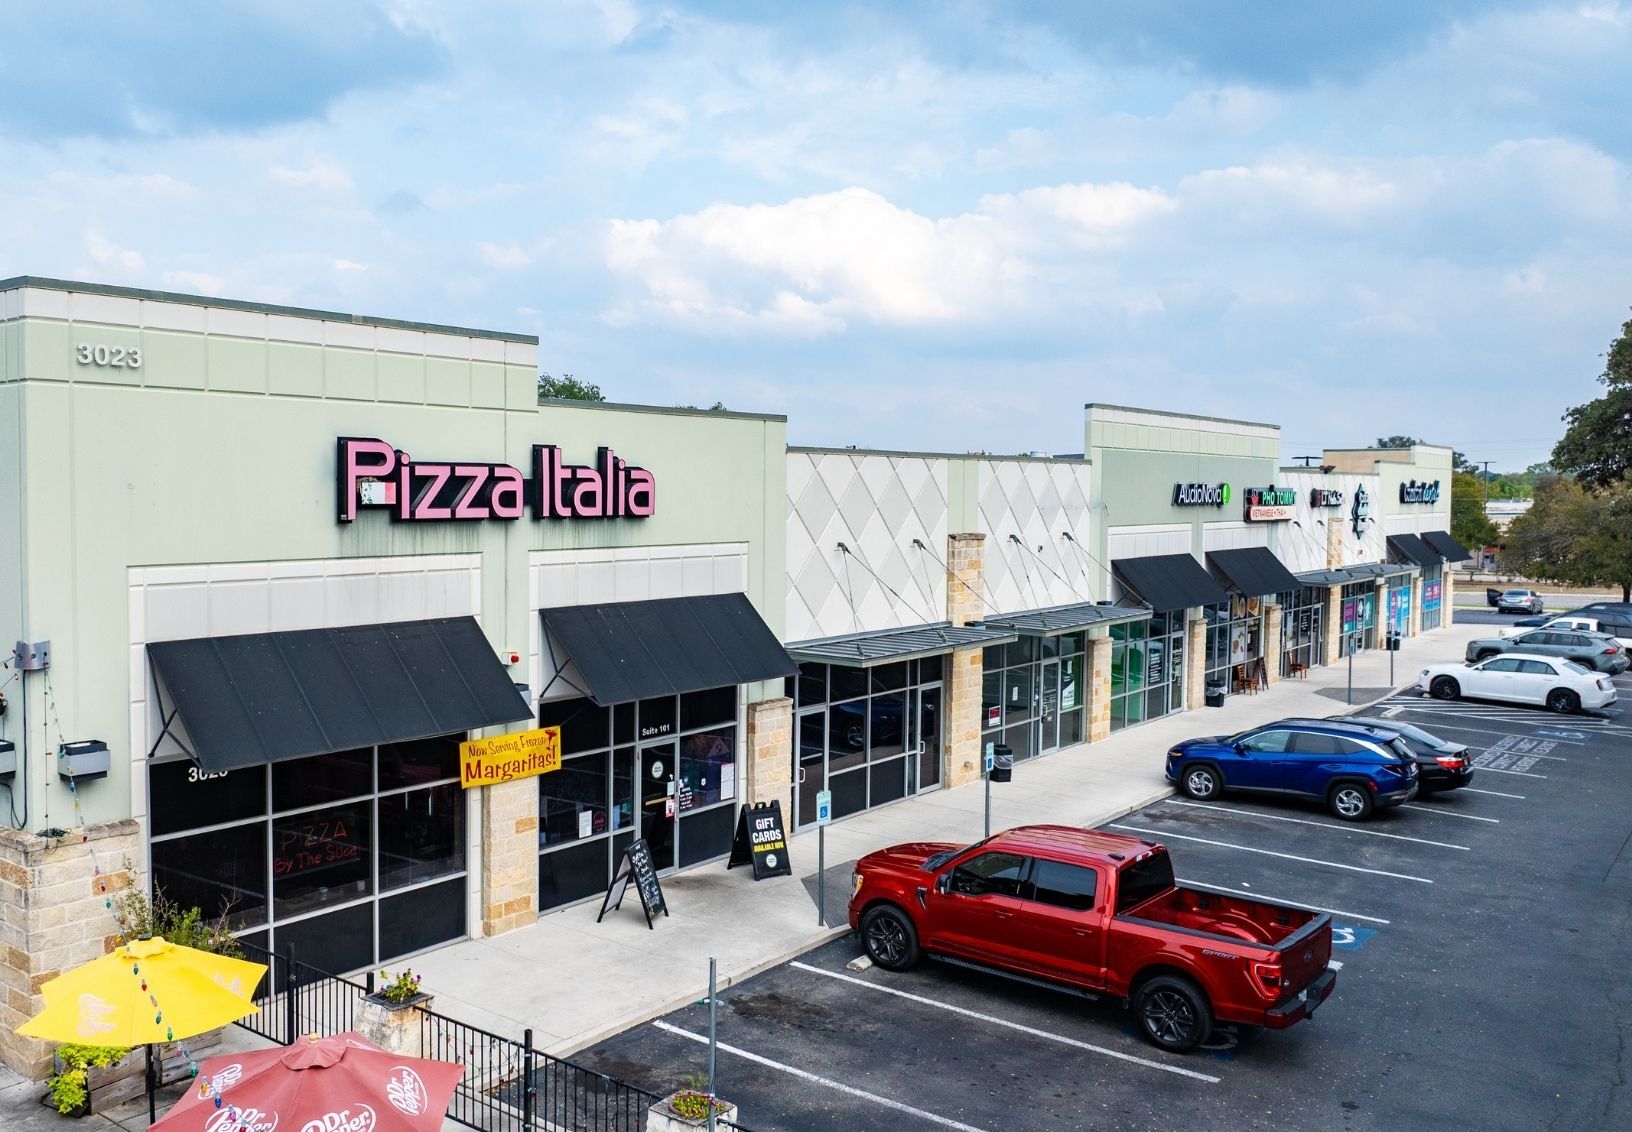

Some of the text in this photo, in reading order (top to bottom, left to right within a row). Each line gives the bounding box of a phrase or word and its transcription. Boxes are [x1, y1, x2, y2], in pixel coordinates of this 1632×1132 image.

[77, 343, 143, 369] 3023
[345, 439, 656, 521] Pizza Italia
[1177, 483, 1222, 503] AudioNova
[1262, 491, 1275, 506] PHO
[641, 723, 670, 737] Suite 101
[468, 735, 546, 758] Now Serving Frozen
[465, 744, 557, 783] Margaritas!
[755, 816, 775, 830] GIFT
[752, 829, 782, 844] CARDS
[754, 842, 775, 853] AVAILABLE
[296, 851, 321, 870] The
[389, 1070, 420, 1116] Pepper
[322, 1109, 350, 1131] Dr
